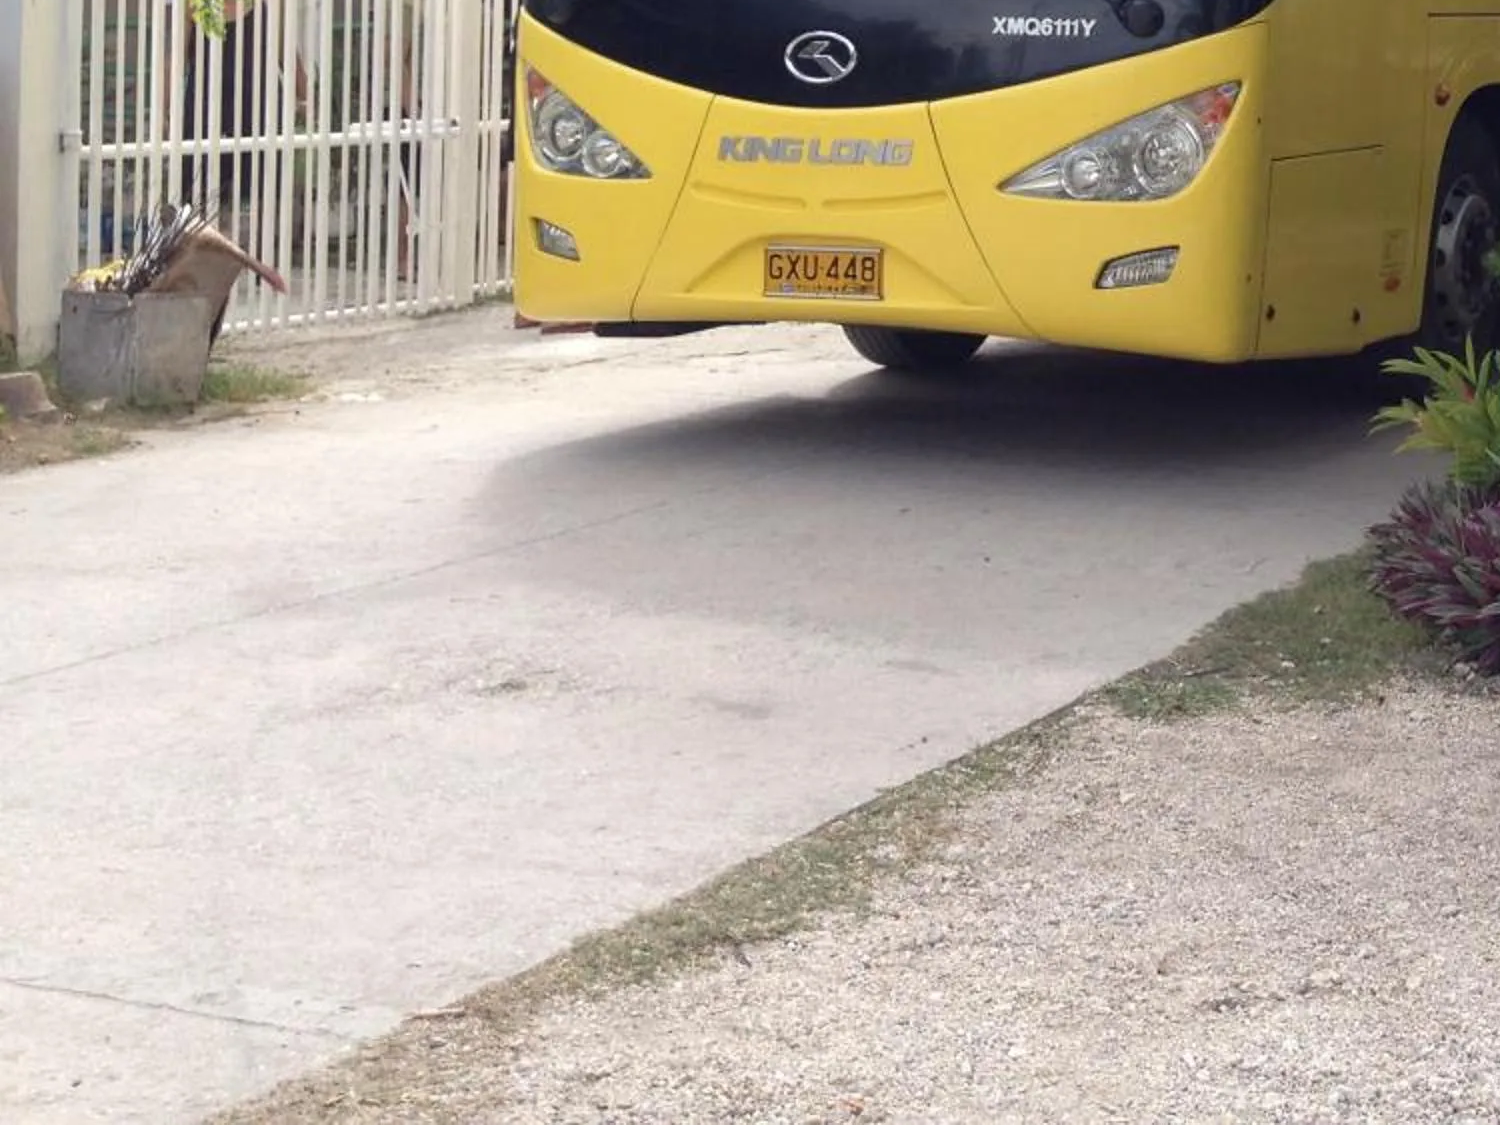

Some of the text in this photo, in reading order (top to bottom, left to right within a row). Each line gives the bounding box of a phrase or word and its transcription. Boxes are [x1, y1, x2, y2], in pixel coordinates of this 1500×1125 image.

[992, 16, 1097, 39] XMQ6111Y
[717, 135, 915, 167] KING LONG
